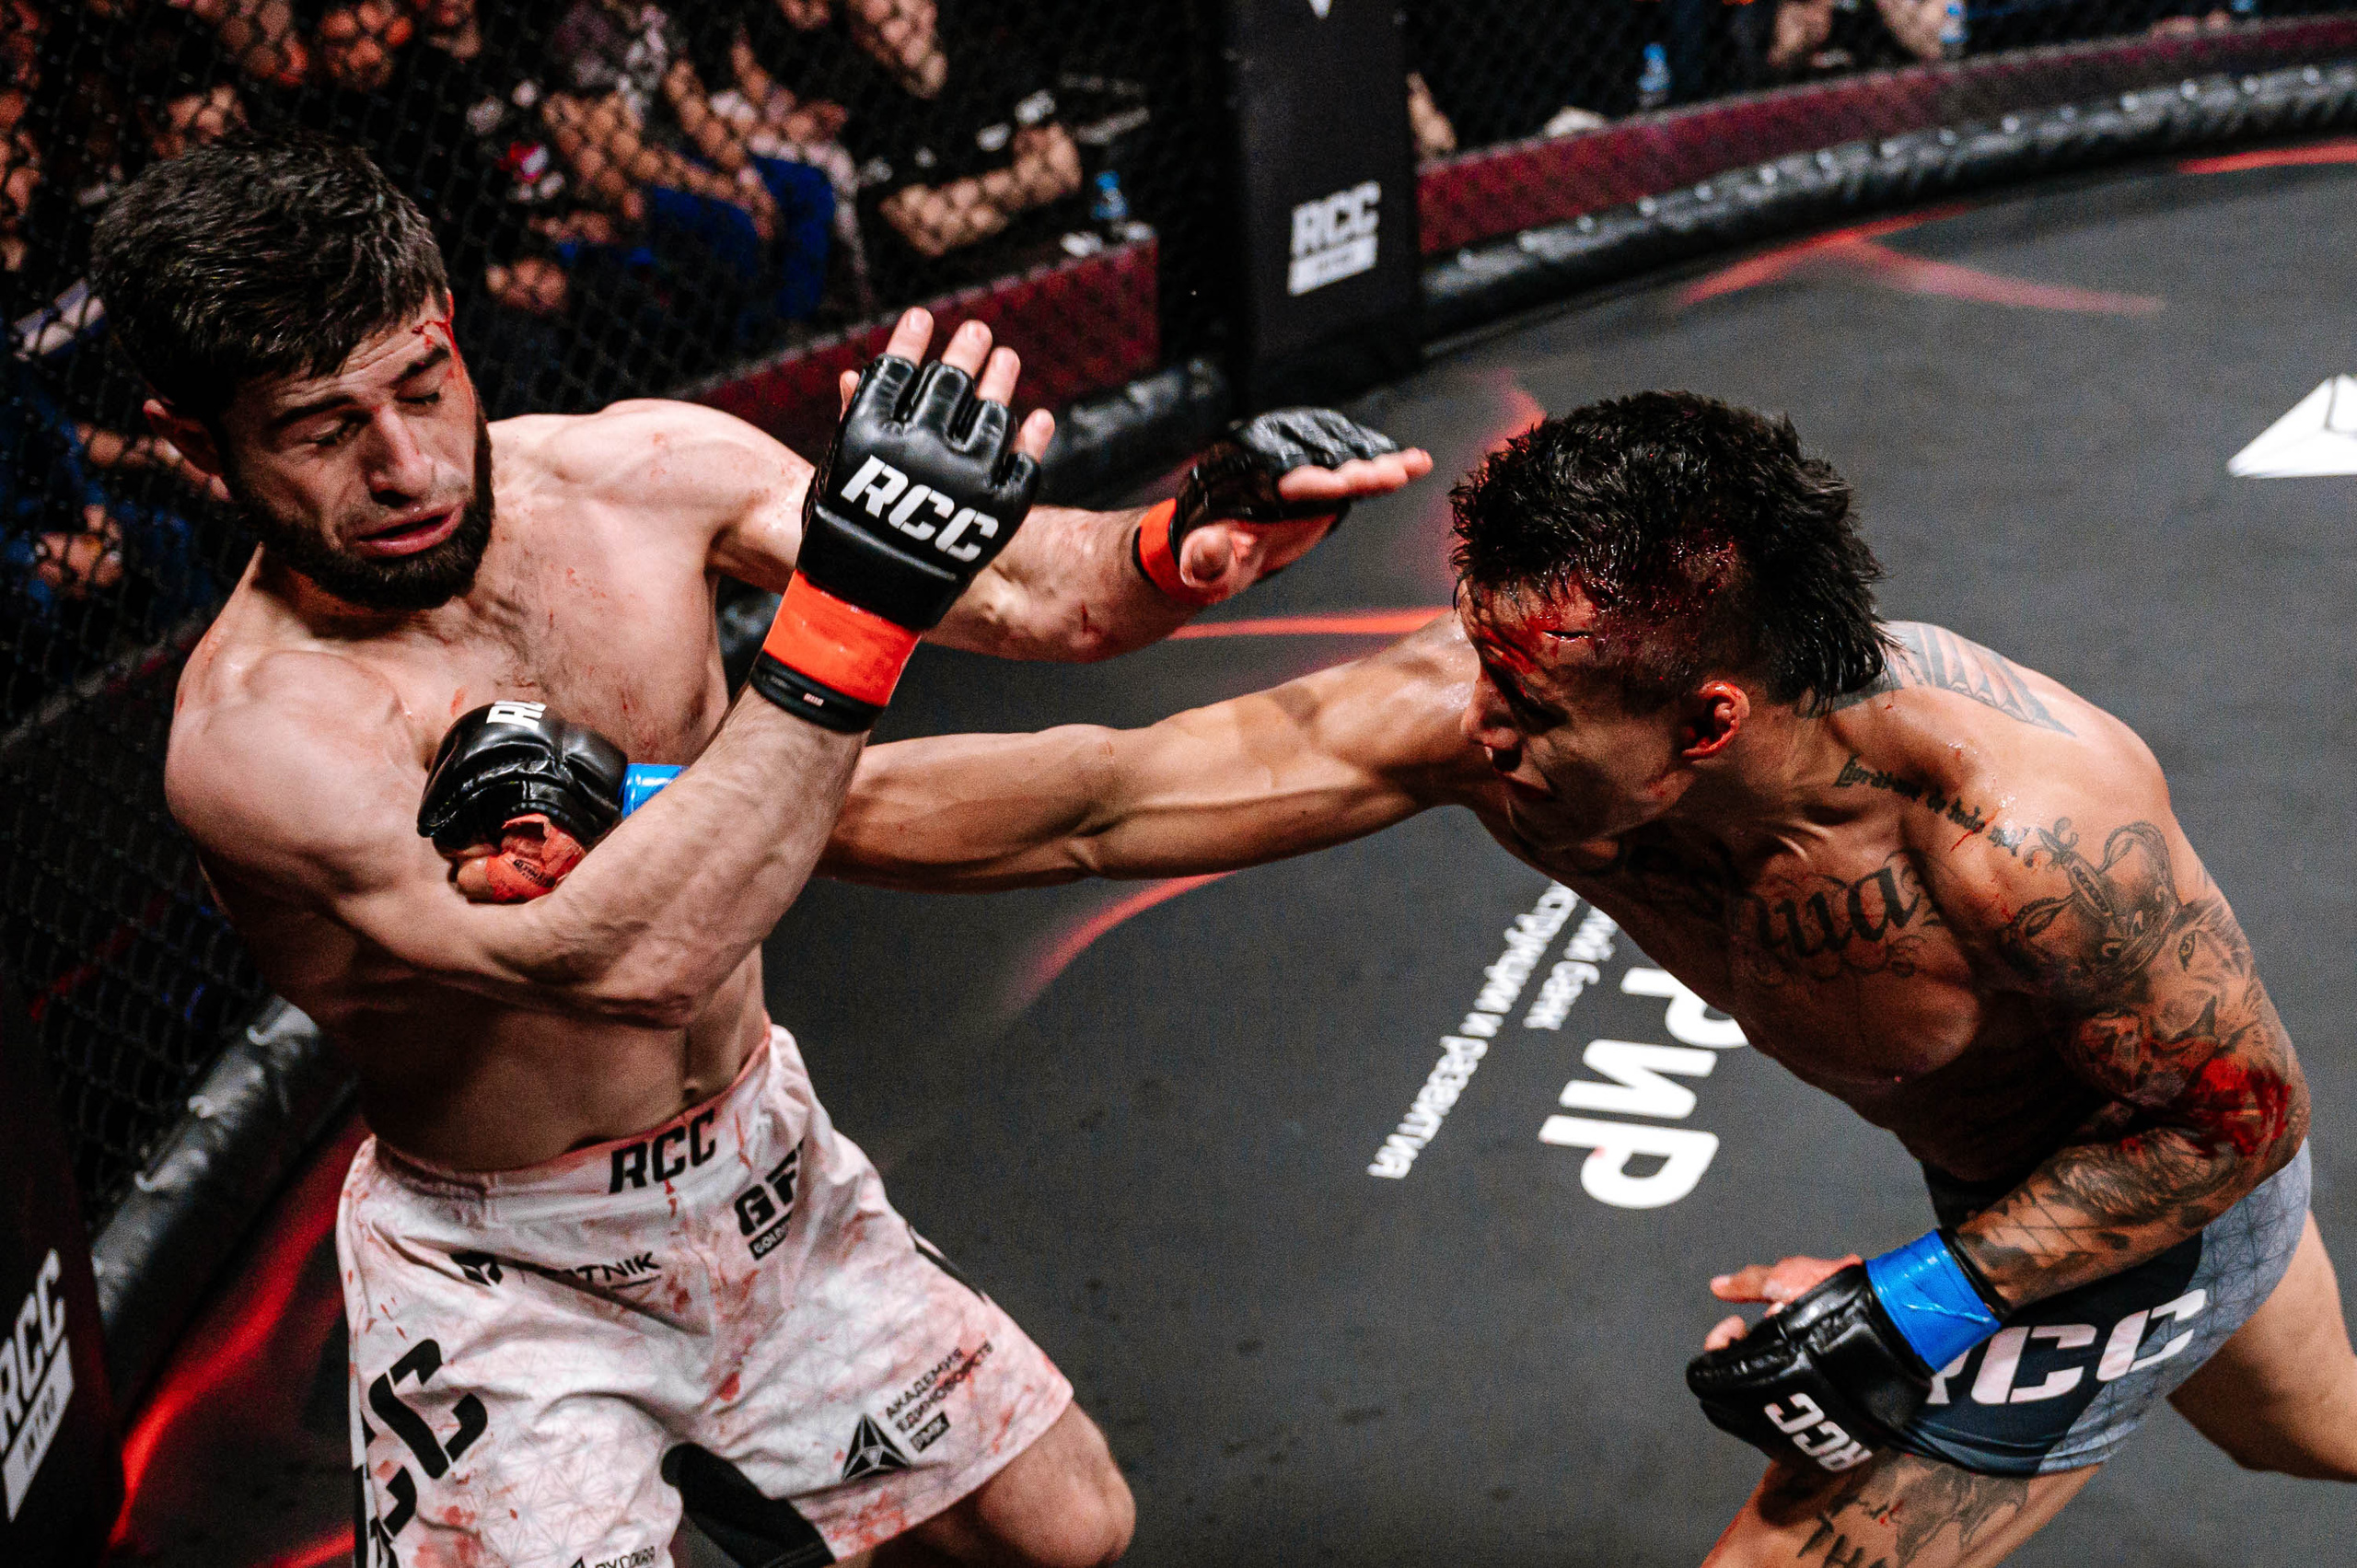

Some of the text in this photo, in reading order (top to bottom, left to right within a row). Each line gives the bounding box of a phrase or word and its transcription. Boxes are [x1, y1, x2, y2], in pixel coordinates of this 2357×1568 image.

[1292, 180, 1381, 258] RCC
[840, 454, 1000, 563] RCC
[1522, 961, 1600, 1030] банк
[1367, 1036, 1489, 1179] развития
[609, 1108, 716, 1195] RCC
[886, 1347, 964, 1421] АКАДЕМИЯ
[1764, 1392, 1873, 1471] RCC
